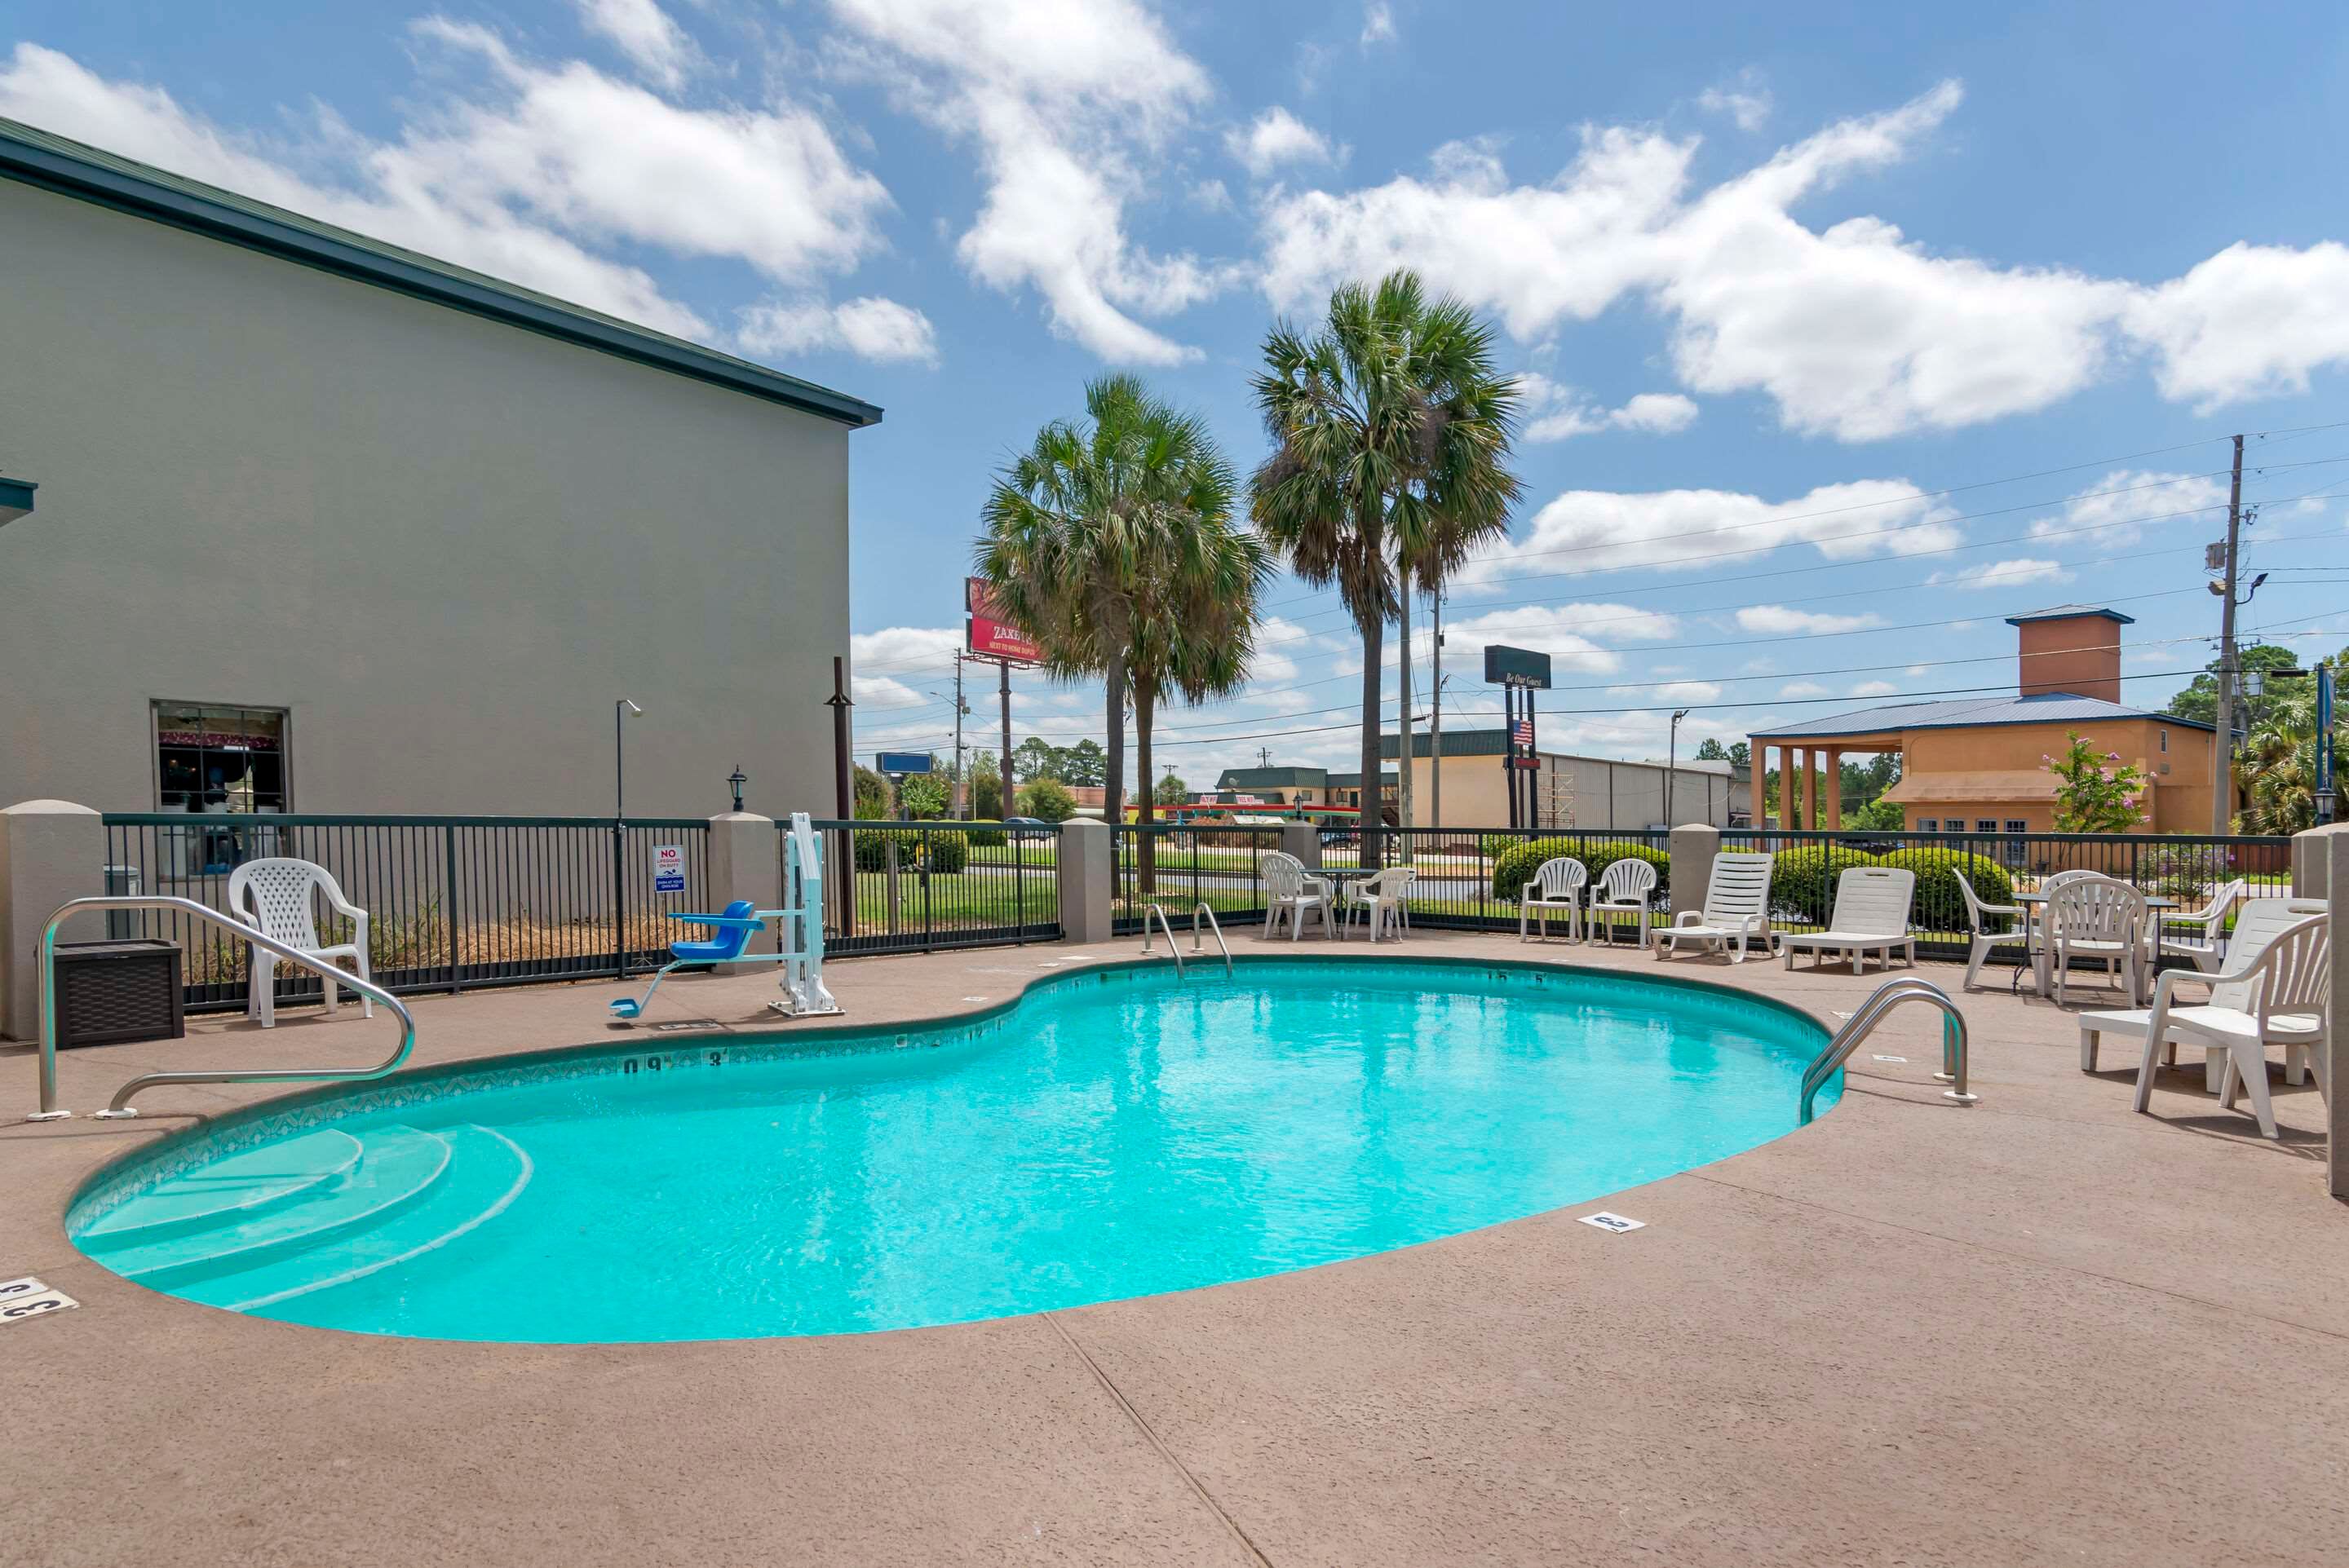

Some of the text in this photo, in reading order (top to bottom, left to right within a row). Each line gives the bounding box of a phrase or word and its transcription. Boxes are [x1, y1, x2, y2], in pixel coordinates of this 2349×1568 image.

[1506, 672, 1542, 687] Be Our Guest
[661, 850, 676, 858] NO
